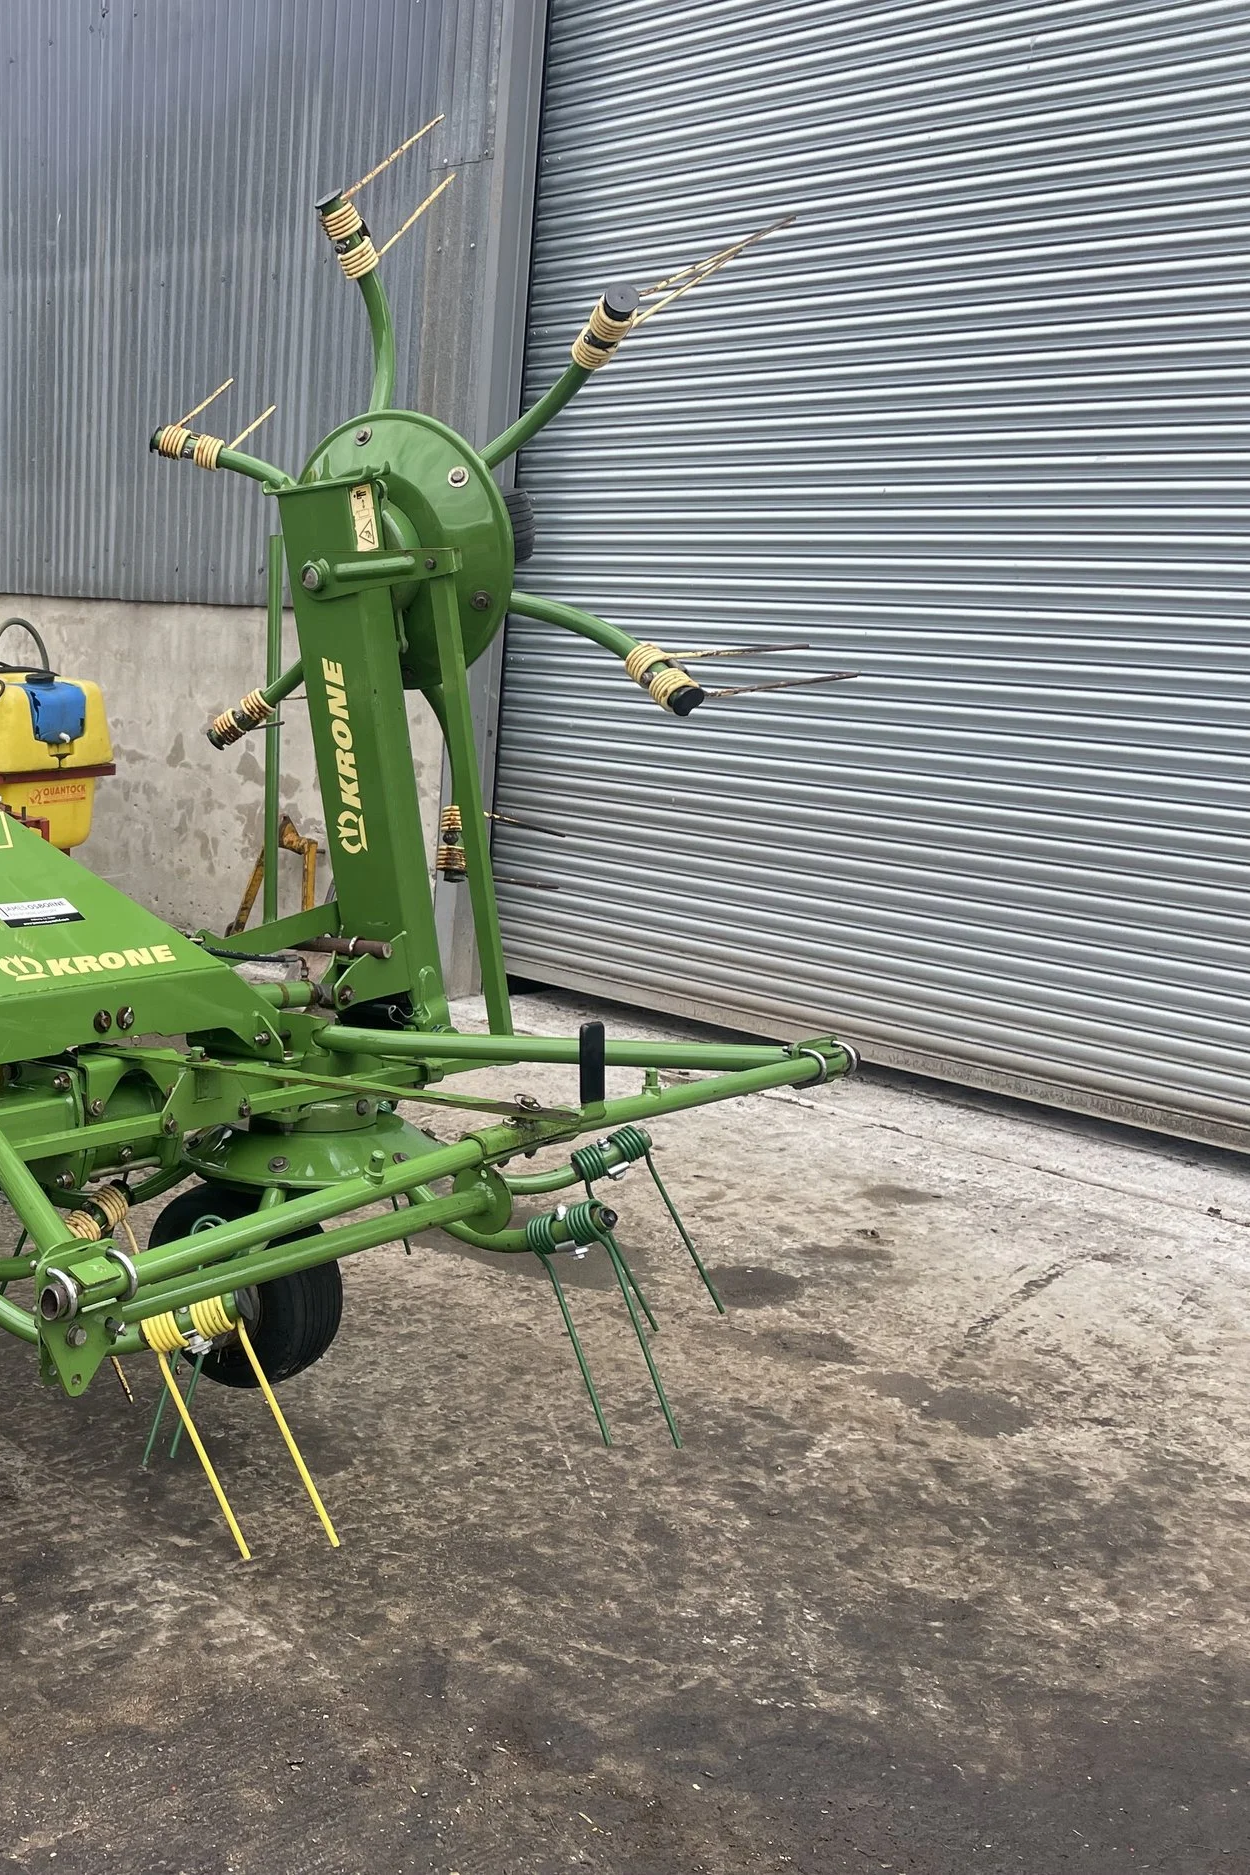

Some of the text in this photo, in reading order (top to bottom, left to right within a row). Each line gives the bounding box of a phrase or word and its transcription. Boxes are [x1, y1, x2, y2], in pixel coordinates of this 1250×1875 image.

[321, 657, 362, 810] KRONE
[43, 784, 86, 796] QUANTOCK
[27, 901, 66, 910] OSBORNE
[45, 944, 177, 977] KRONE
